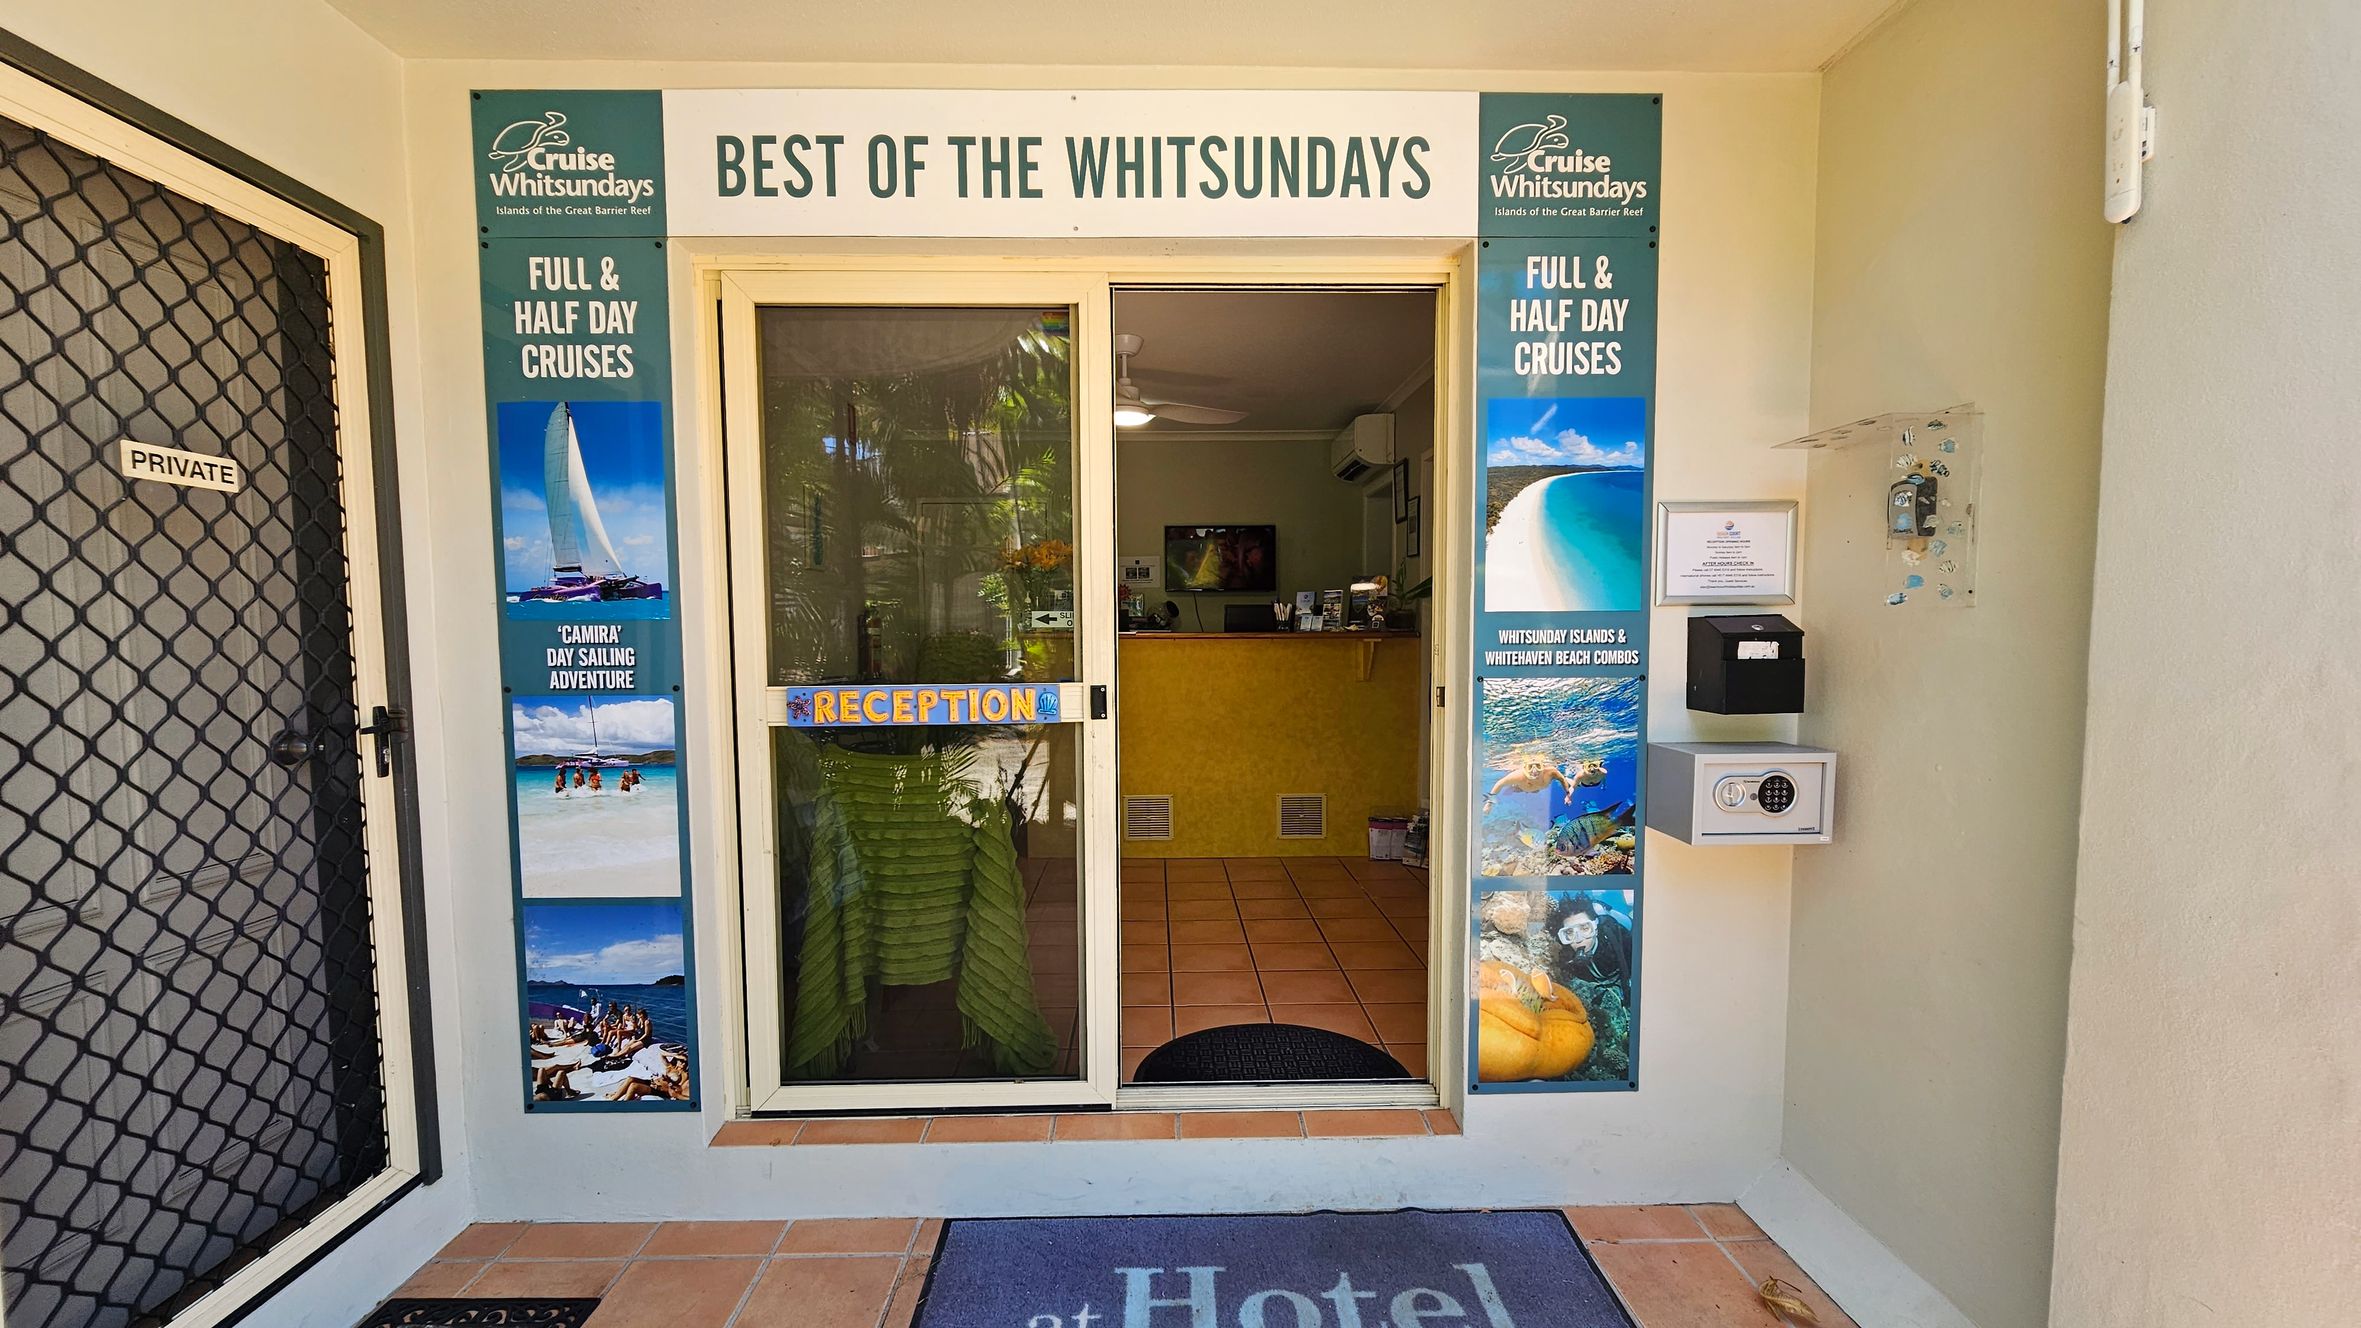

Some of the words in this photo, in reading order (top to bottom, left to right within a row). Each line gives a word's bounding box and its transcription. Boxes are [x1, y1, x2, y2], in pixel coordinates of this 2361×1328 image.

[527, 147, 614, 171] Cruise
[716, 133, 845, 199] BEST
[867, 134, 929, 199] OF
[947, 135, 1044, 199] THE
[1065, 135, 1431, 200] WHITSUNDAYS
[1528, 148, 1611, 173] Cruise
[490, 172, 654, 204] Whitsundays
[1490, 174, 1647, 206] Whitsundays
[496, 205, 530, 215] Islands
[532, 205, 543, 215] of
[545, 205, 562, 215] the
[564, 205, 593, 215] Great
[595, 205, 628, 215] Barrier
[630, 205, 651, 215] Reef
[1494, 206, 1527, 217] Islands
[1529, 206, 1540, 217] of
[1542, 206, 1558, 217] the
[1560, 207, 1587, 217] Great
[1589, 207, 1621, 217] Barrier
[1623, 207, 1644, 217] Reef
[528, 256, 592, 291] FULL
[600, 255, 620, 291] &
[1526, 255, 1586, 290] FULL
[1594, 254, 1613, 290] &
[514, 301, 581, 334] HALF
[589, 301, 638, 334] DAY
[1510, 299, 1573, 332] HALF
[1581, 299, 1630, 332] DAY
[521, 344, 634, 379] CRUISES
[1514, 341, 1622, 376] CRUISES
[131, 450, 235, 484] PRIVATE
[558, 625, 622, 644] ‘CAMIRA’
[1498, 630, 1568, 644] WHITSUNDAY
[1570, 629, 1615, 643] ISLANDS
[1618, 629, 1627, 643] &
[547, 648, 575, 667] DAY
[578, 647, 636, 667] SAILING
[1485, 651, 1552, 665] WHITEHAVEN
[1556, 650, 1591, 665] BEACH
[1594, 649, 1639, 664] COMBOS
[549, 670, 635, 689] ADVENTURE
[813, 688, 1036, 724] RECEPTION
[1114, 1263, 1516, 1328] Hotel
